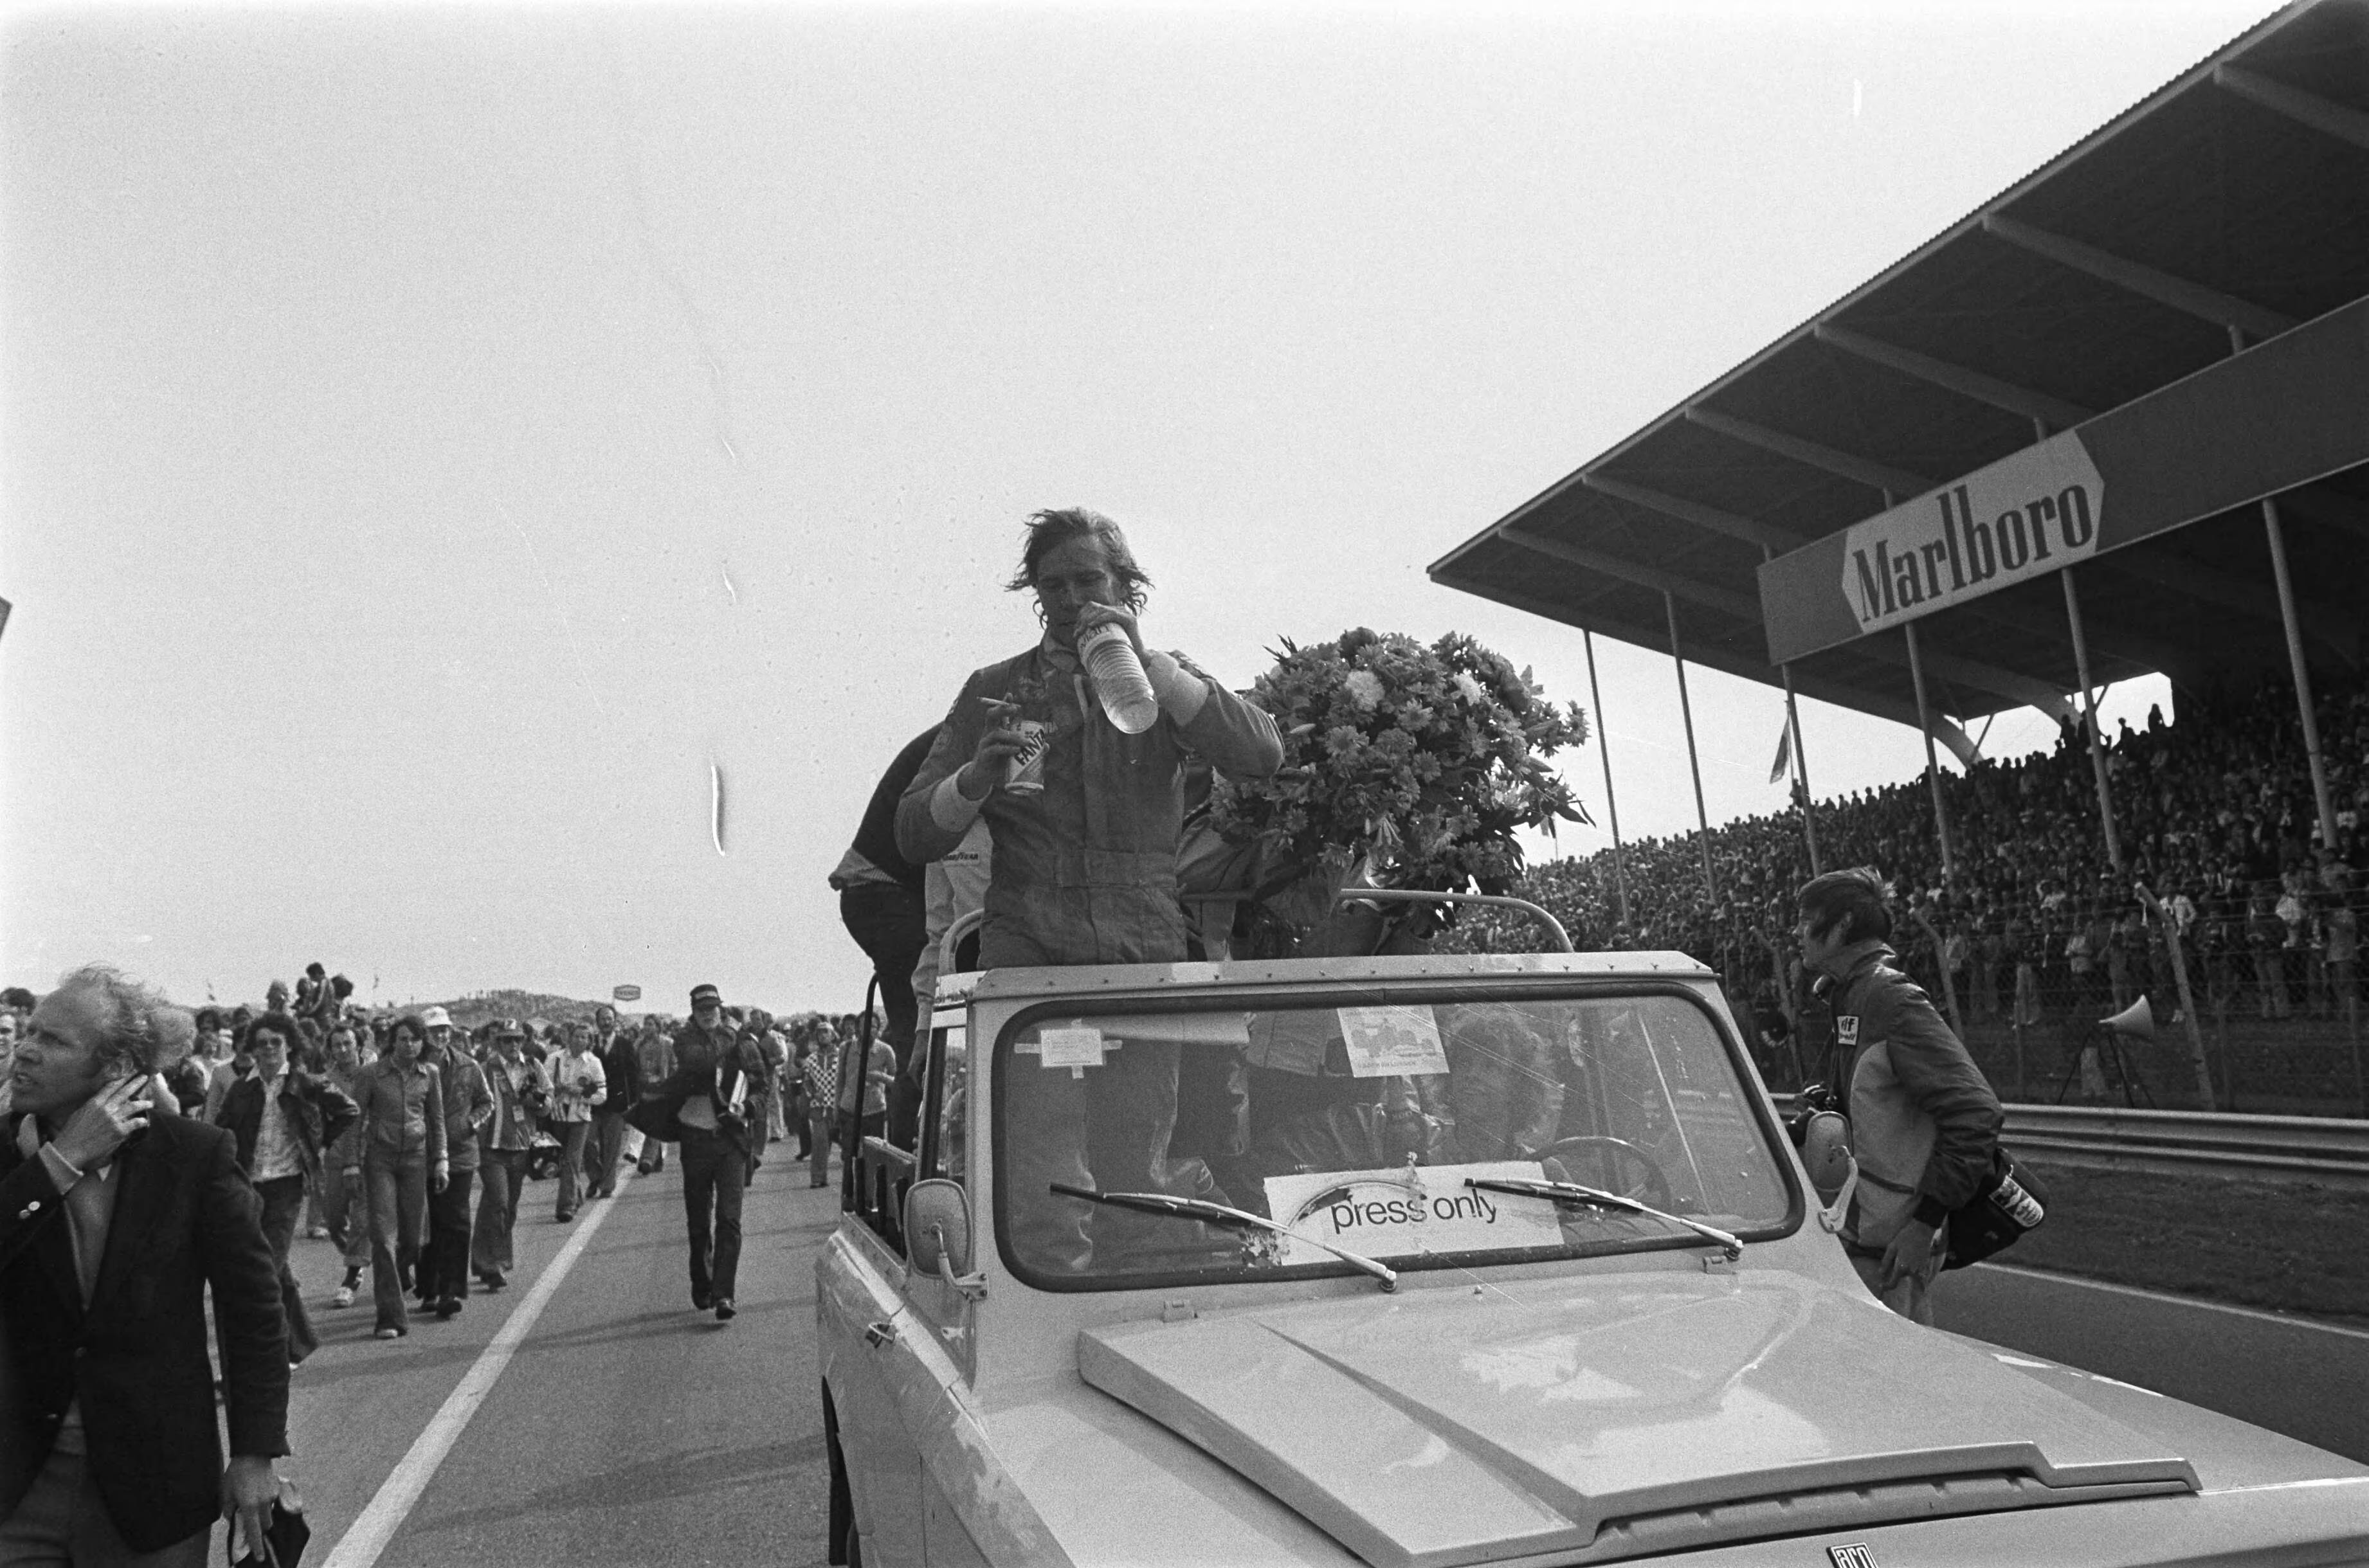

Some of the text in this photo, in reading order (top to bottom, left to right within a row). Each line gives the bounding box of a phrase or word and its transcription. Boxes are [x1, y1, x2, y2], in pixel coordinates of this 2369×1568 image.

[1853, 484, 2092, 622] Marlboro
[1330, 1187, 1496, 1234] press only
